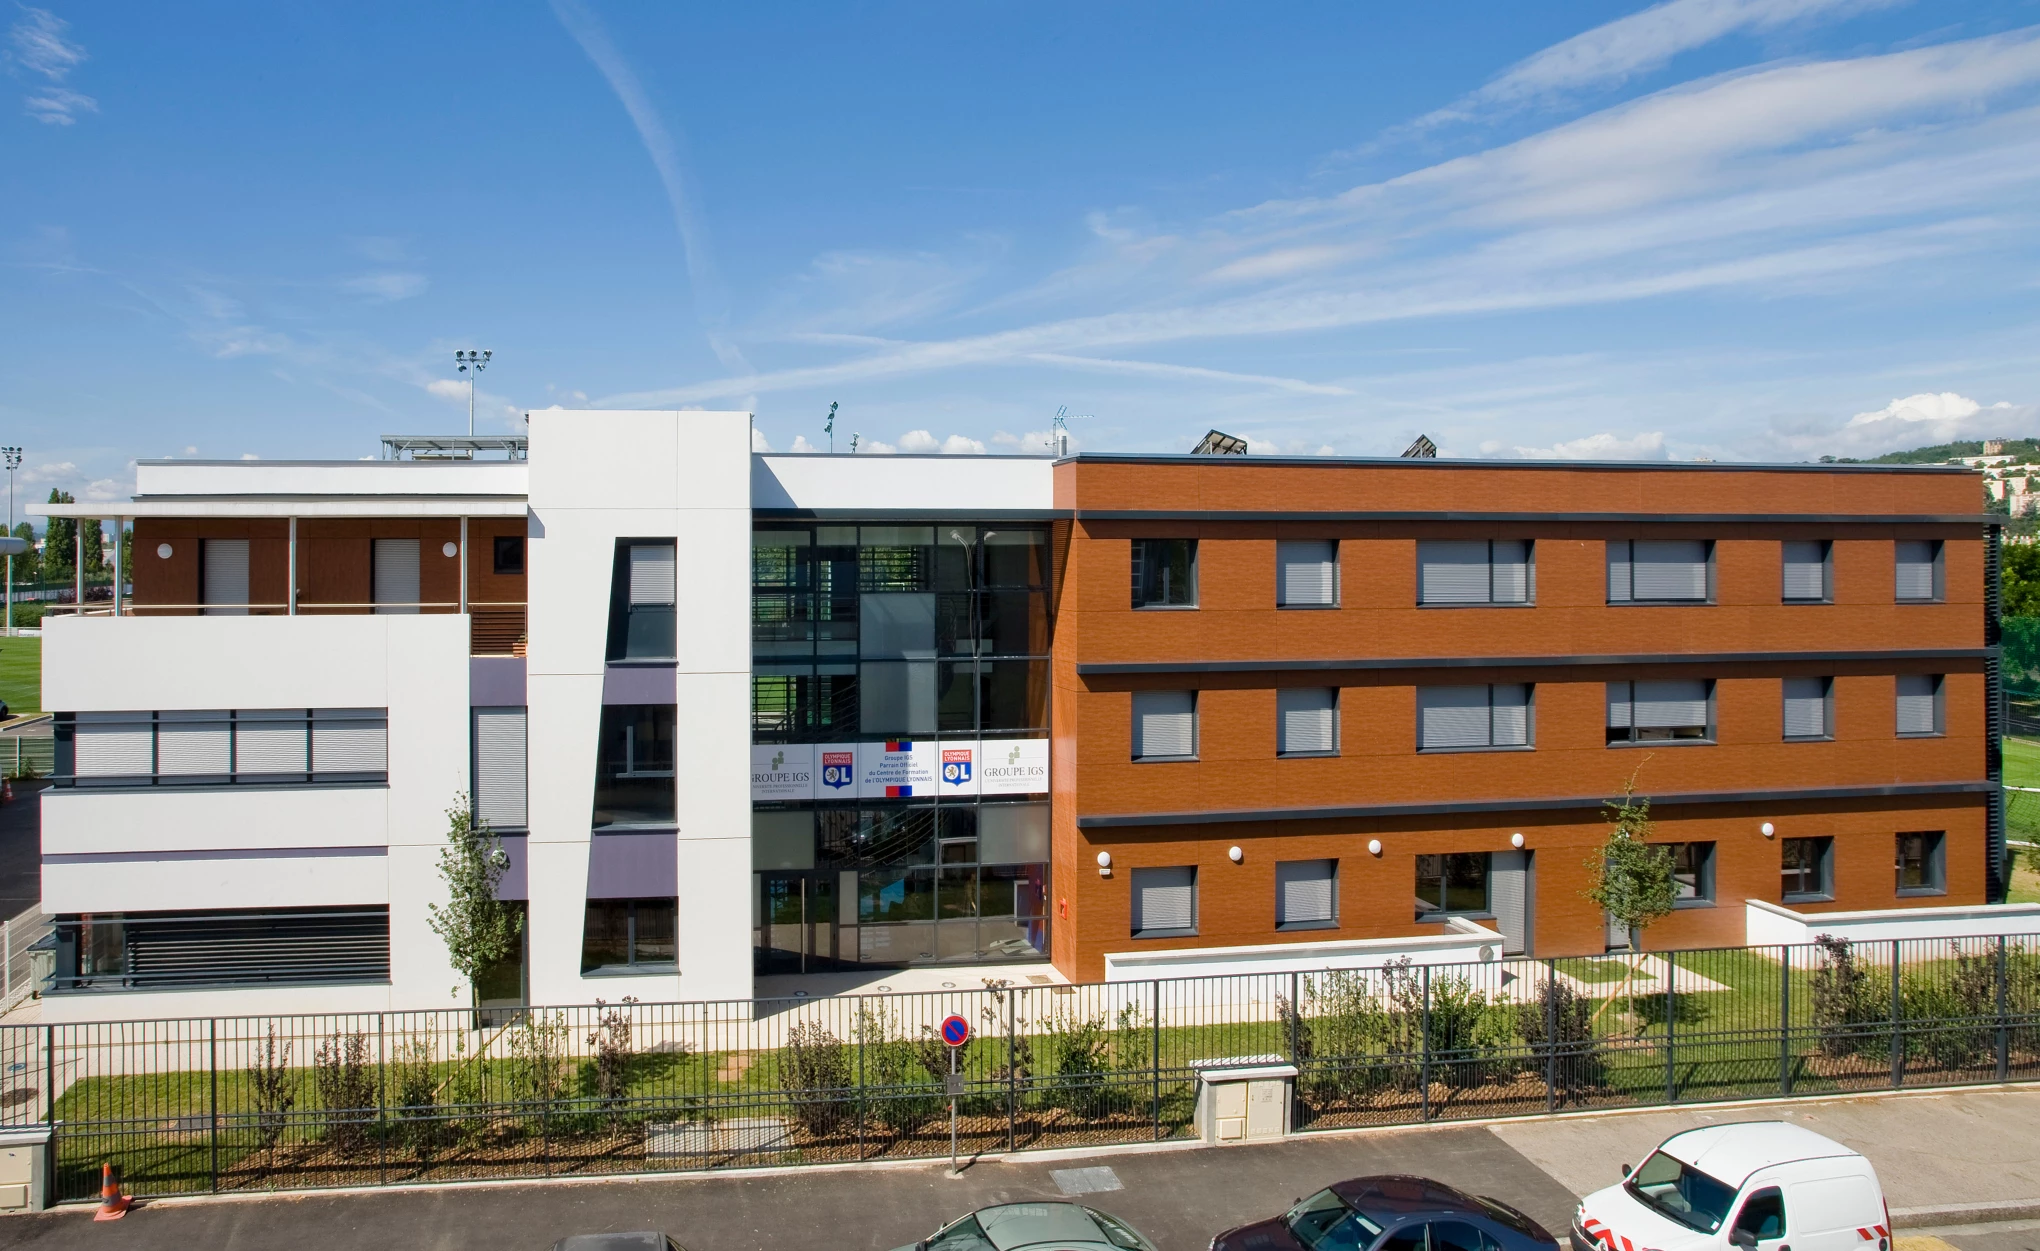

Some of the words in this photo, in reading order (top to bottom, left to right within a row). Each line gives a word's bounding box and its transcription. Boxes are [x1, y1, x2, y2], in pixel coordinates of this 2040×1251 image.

[984, 767, 1026, 777] GROUPE
[1027, 766, 1044, 776] IGS
[792, 772, 810, 782] IGS
